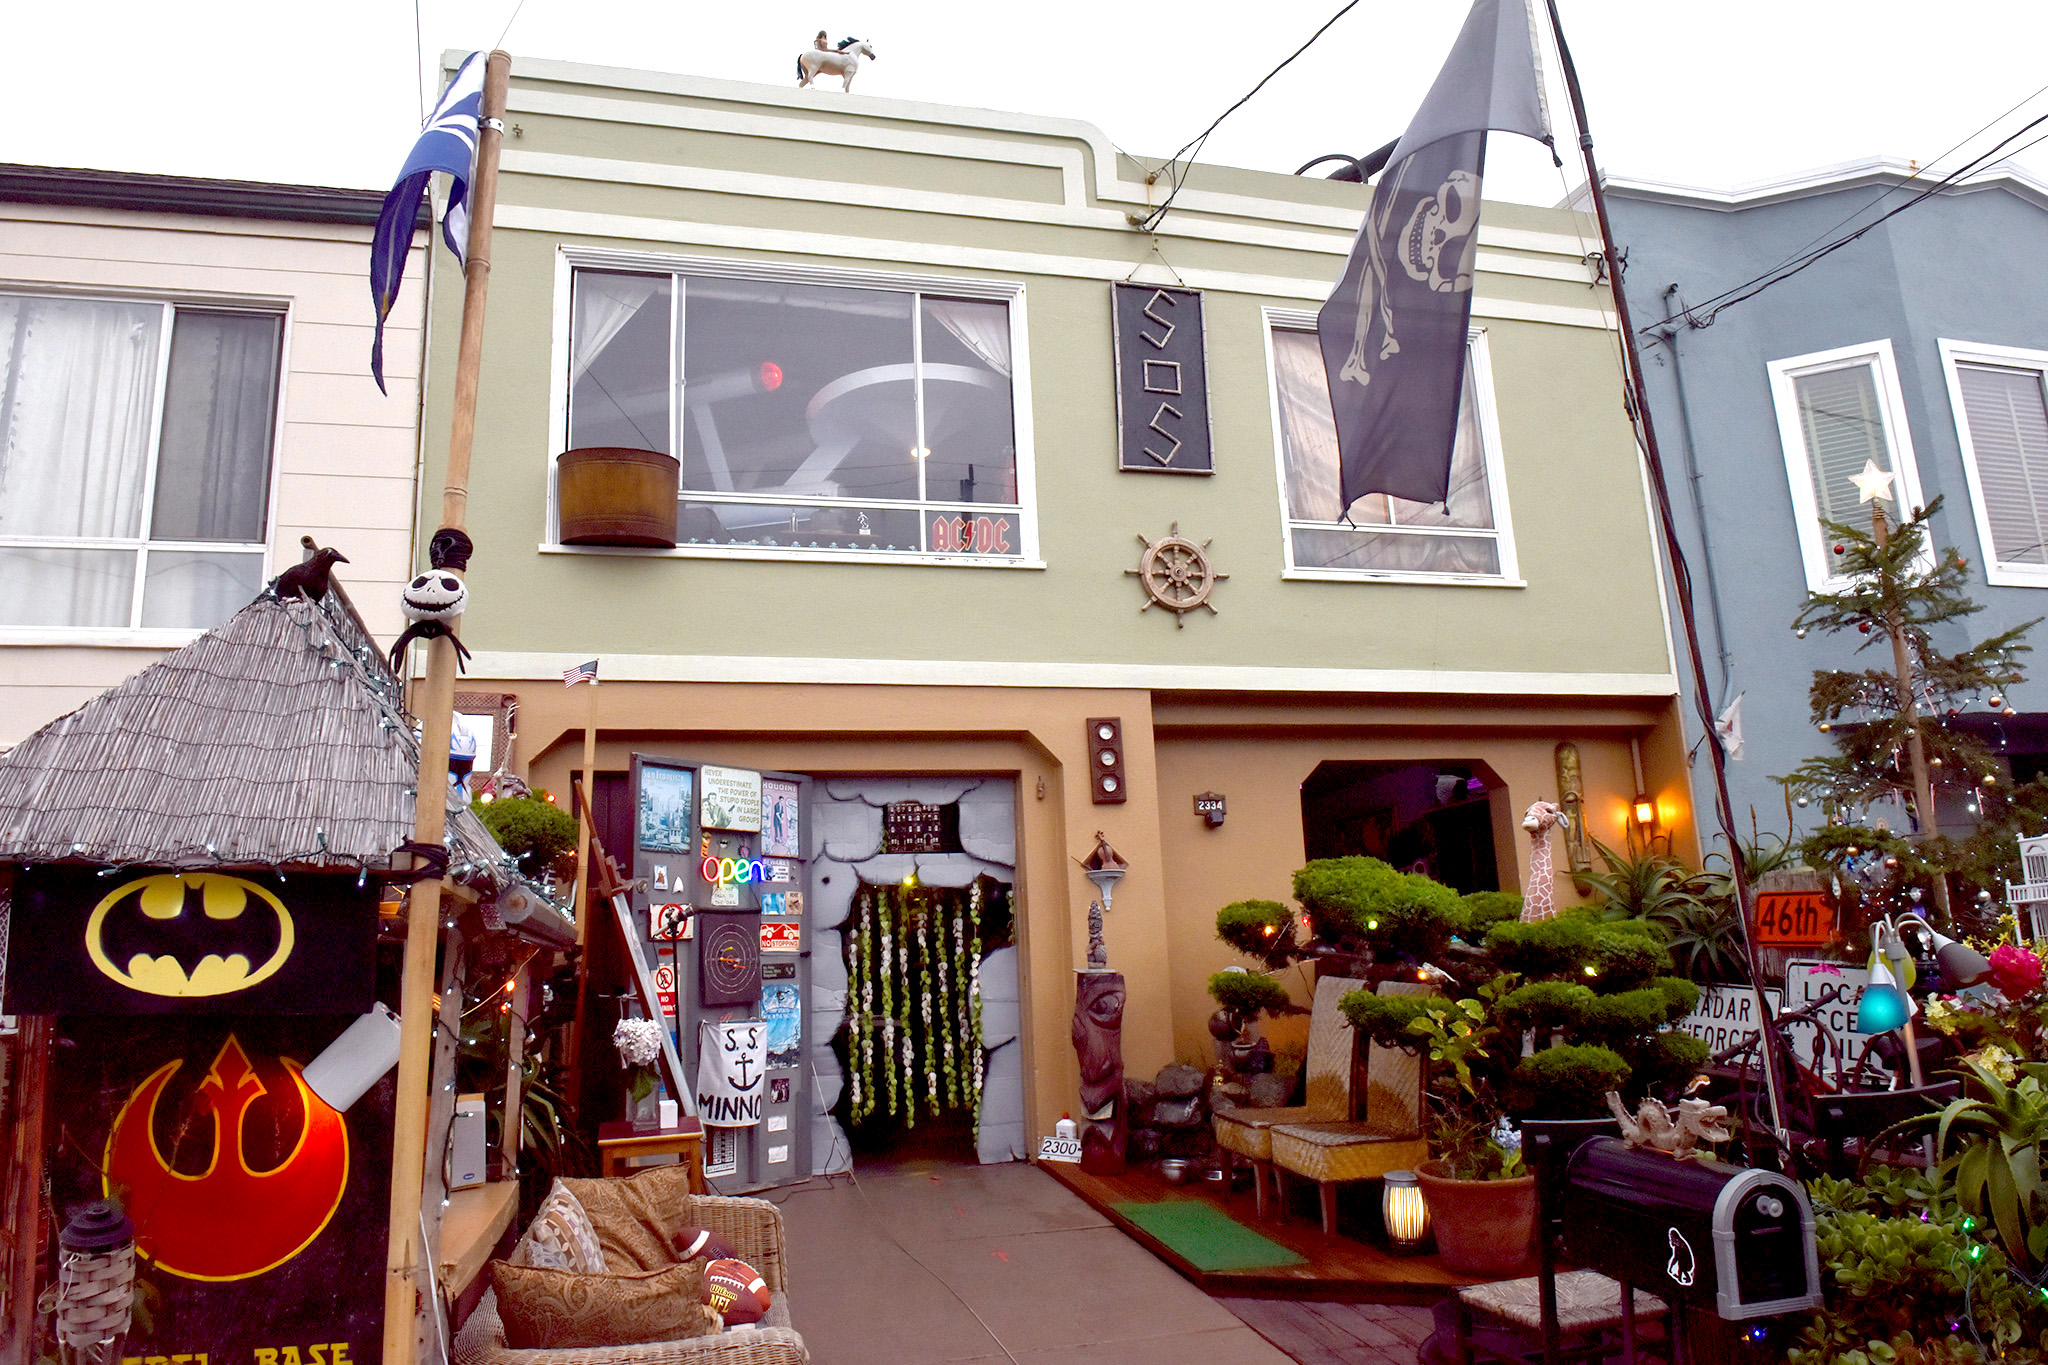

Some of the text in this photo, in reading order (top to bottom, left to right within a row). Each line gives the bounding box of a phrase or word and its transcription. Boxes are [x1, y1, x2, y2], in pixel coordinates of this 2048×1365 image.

[704, 768, 722, 777] NEVER
[708, 777, 752, 789] UNDERESTIMATE
[762, 782, 796, 793] HOUDINI
[718, 787, 758, 798] THE POWER OF
[719, 796, 760, 807] STUPID PEOPLE
[1198, 801, 1222, 810] 2334
[737, 806, 760, 815] IN LARGE
[739, 816, 760, 825] GROUPS
[1761, 898, 1818, 935] 46th
[1804, 981, 1866, 1006] LOCA
[1042, 1140, 1078, 1155] 2300
[710, 1284, 738, 1301] Wilson
[710, 1294, 731, 1313] NFL
